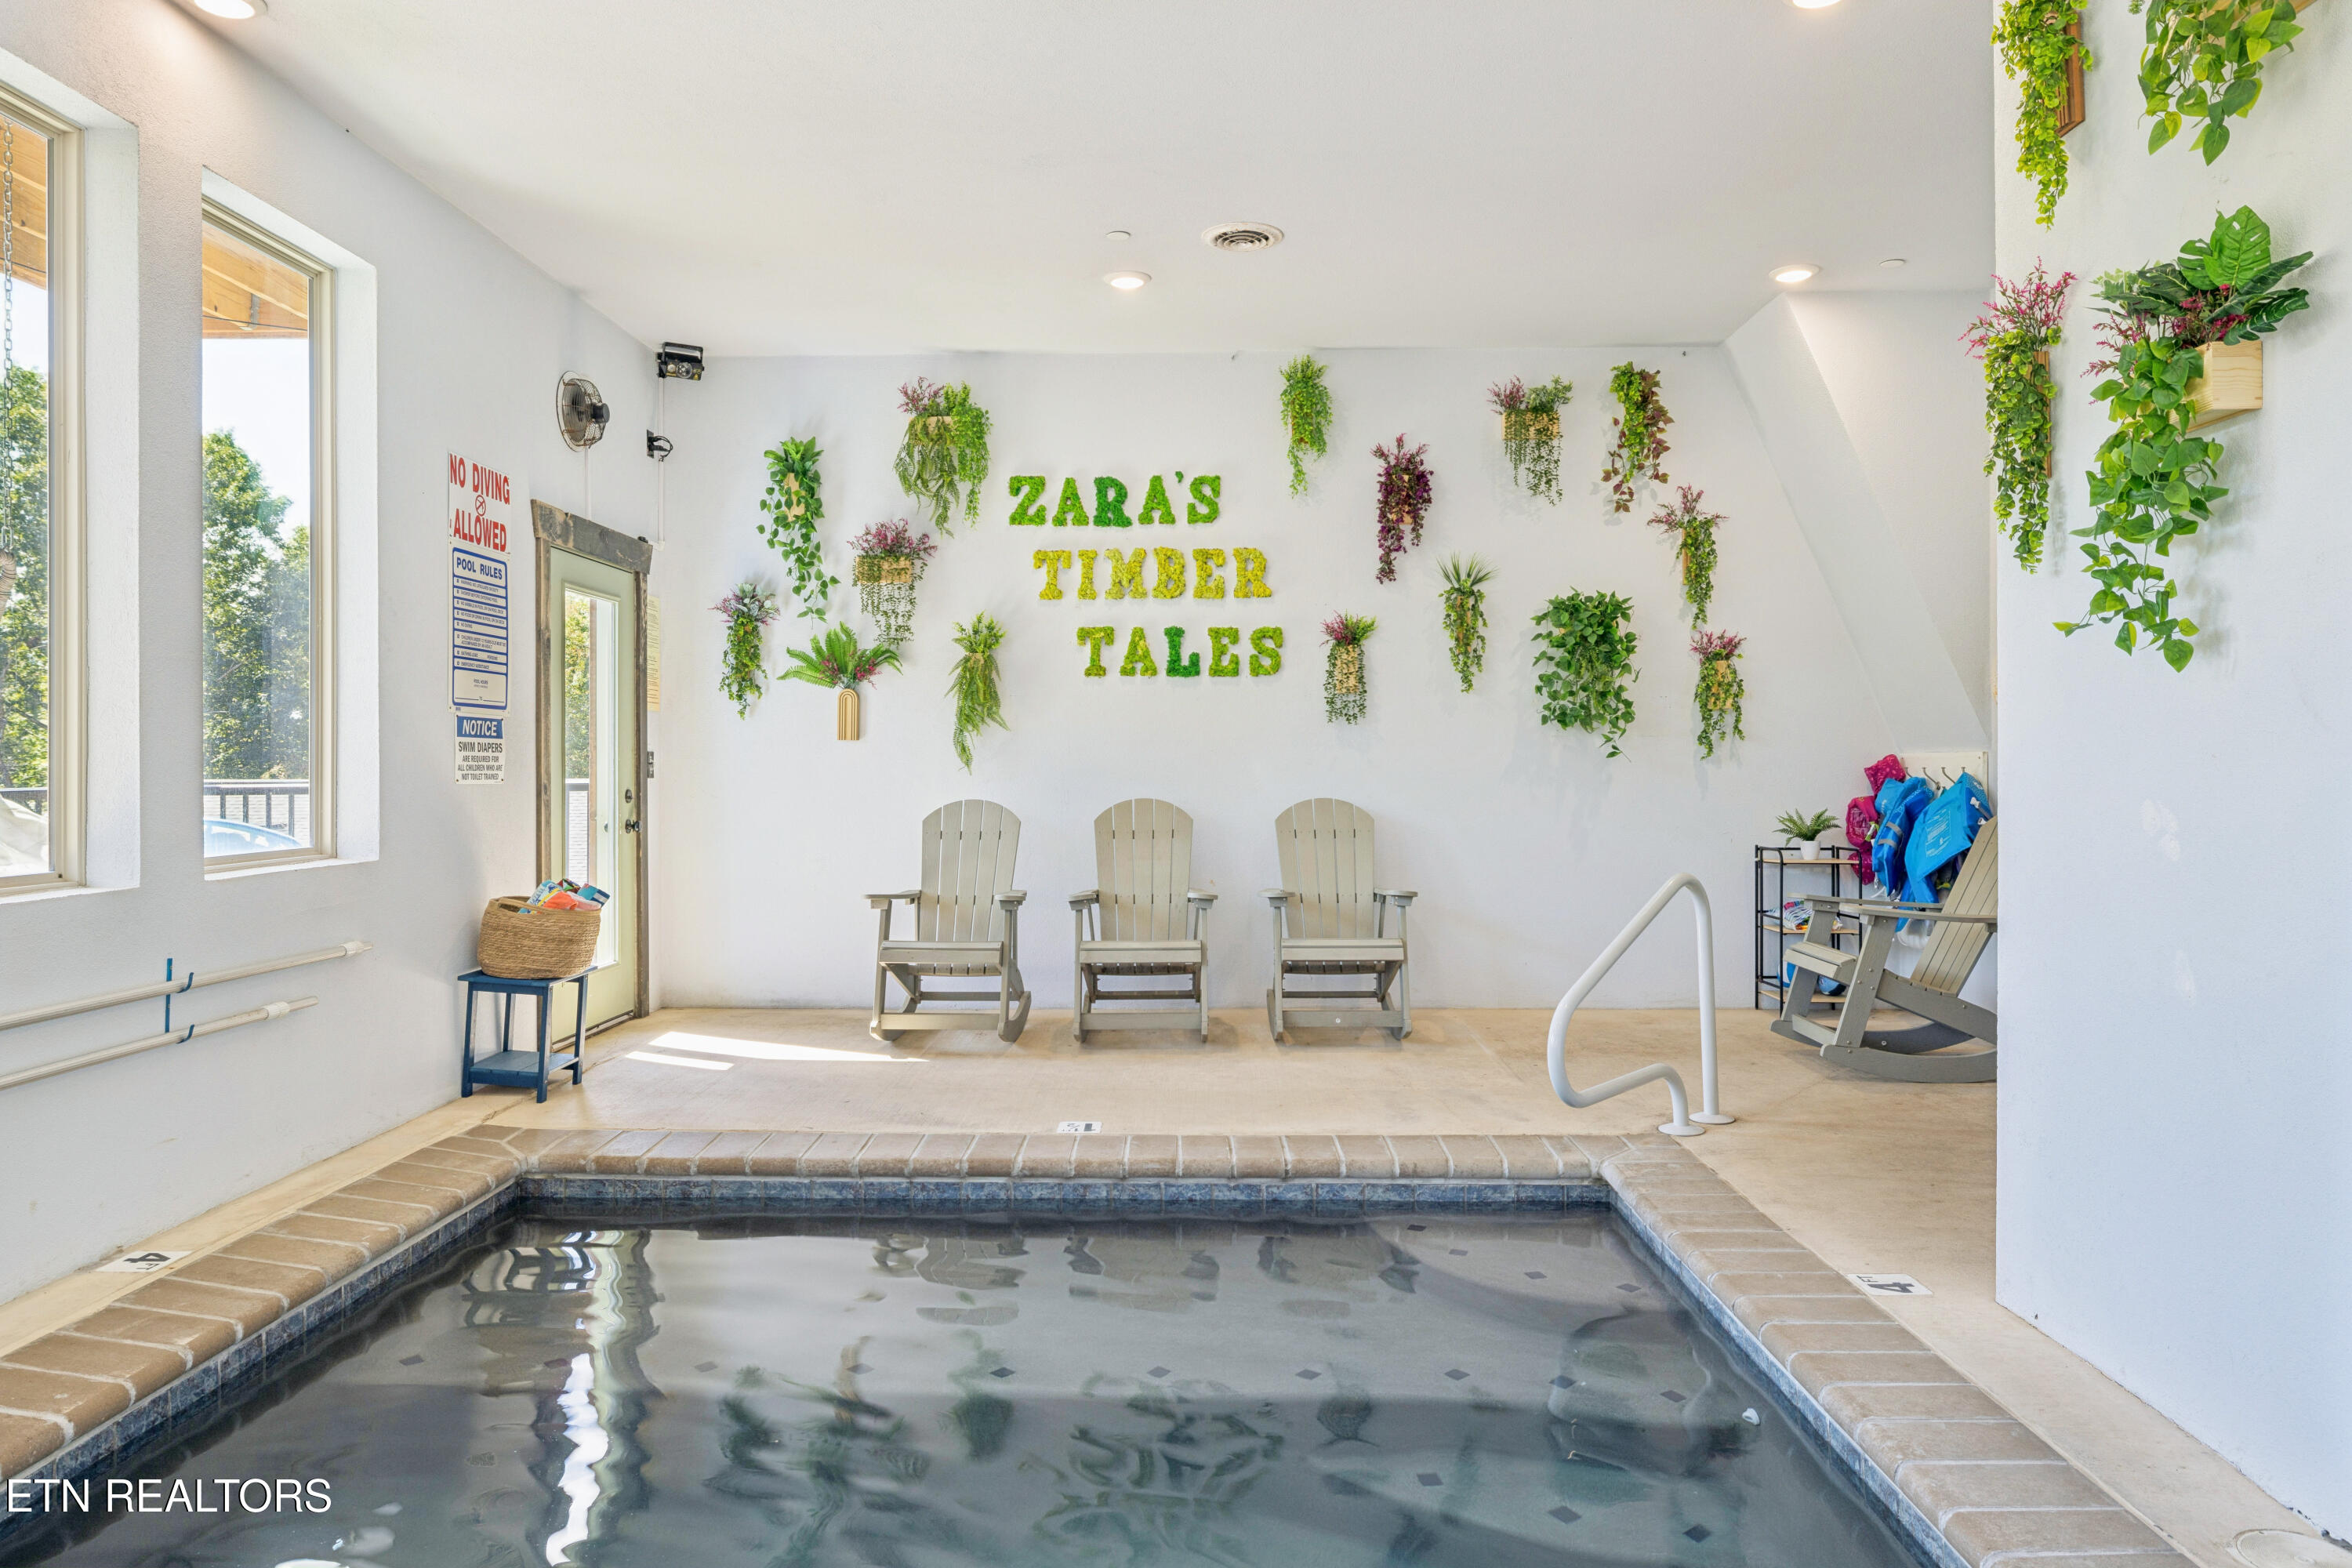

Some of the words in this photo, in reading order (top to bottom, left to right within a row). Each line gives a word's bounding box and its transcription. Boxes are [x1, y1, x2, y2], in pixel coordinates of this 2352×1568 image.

[450, 453, 466, 488] NO
[472, 463, 510, 505] DIVING
[1008, 471, 1221, 528] ZARA'S
[453, 508, 506, 552] ALLOWED
[457, 557, 476, 572] POOL
[481, 564, 503, 580] RULES
[1033, 546, 1272, 601] TIMBER
[1076, 626, 1284, 678] TALES
[459, 742, 475, 753] SWIM
[477, 742, 503, 753] DIAPERS
[463, 719, 497, 735] NOTICE
